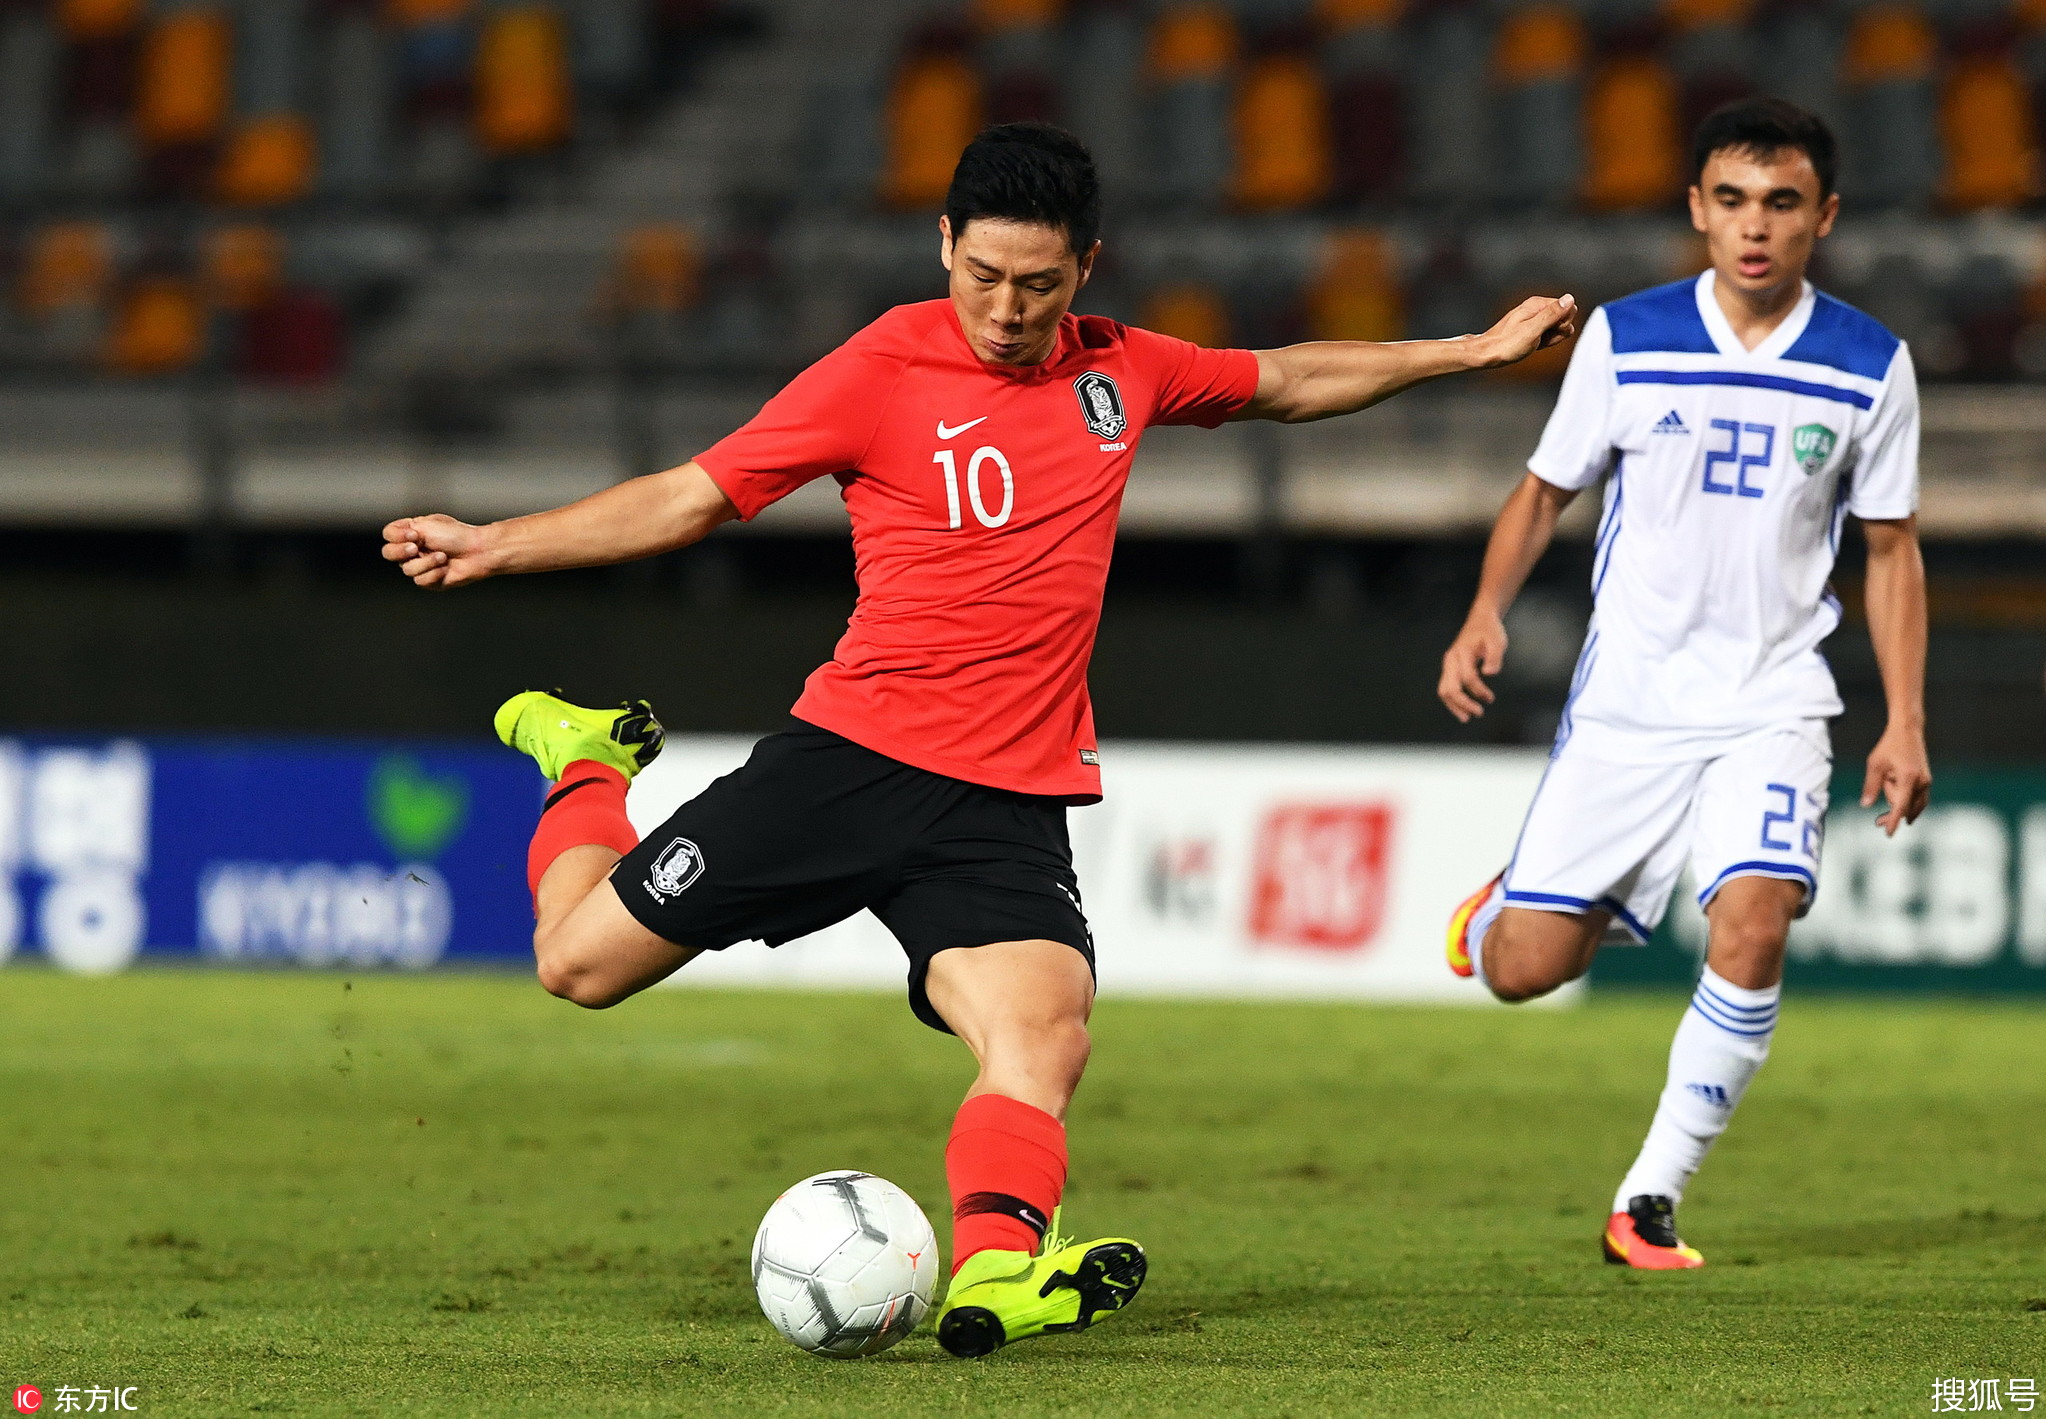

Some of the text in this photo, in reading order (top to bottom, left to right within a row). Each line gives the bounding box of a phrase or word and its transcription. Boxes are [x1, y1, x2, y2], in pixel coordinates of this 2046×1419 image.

[1099, 441, 1128, 453] KOREA
[1702, 418, 1775, 498] 22
[932, 445, 1014, 530] 10
[642, 879, 666, 906] KOREA
